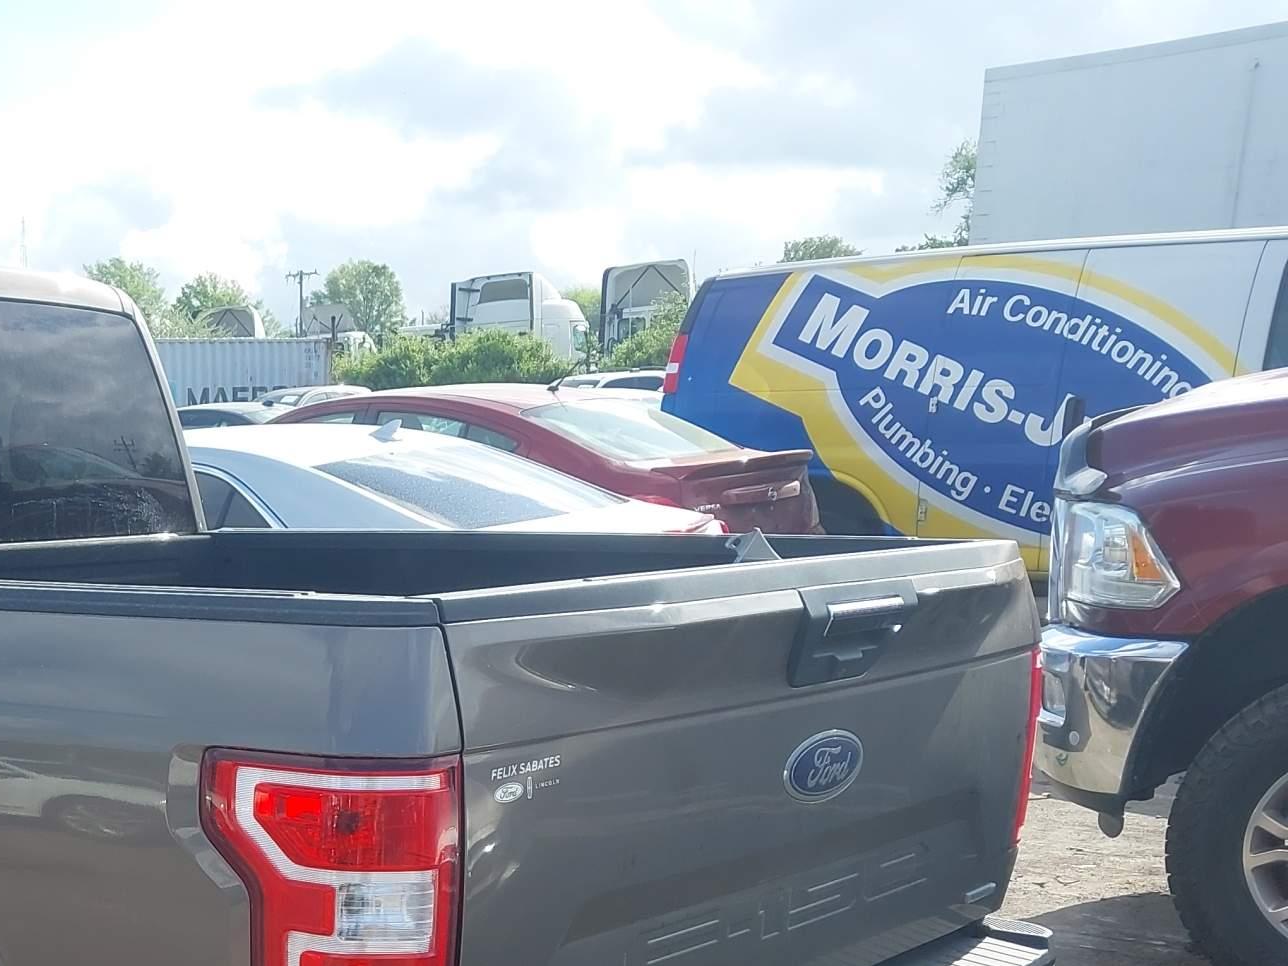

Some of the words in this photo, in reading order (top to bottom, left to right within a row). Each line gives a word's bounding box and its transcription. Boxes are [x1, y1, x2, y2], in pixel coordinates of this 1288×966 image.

[946, 288, 998, 317] Air
[798, 292, 1080, 447] MORRIS-J
[187, 385, 296, 406] MAE
[859, 386, 978, 501] Plumbing
[998, 484, 1054, 523] Ele
[491, 764, 518, 781] FELIX
[519, 755, 561, 775] SABATES
[808, 745, 852, 788] Ford
[535, 778, 560, 789] LINCOLN
